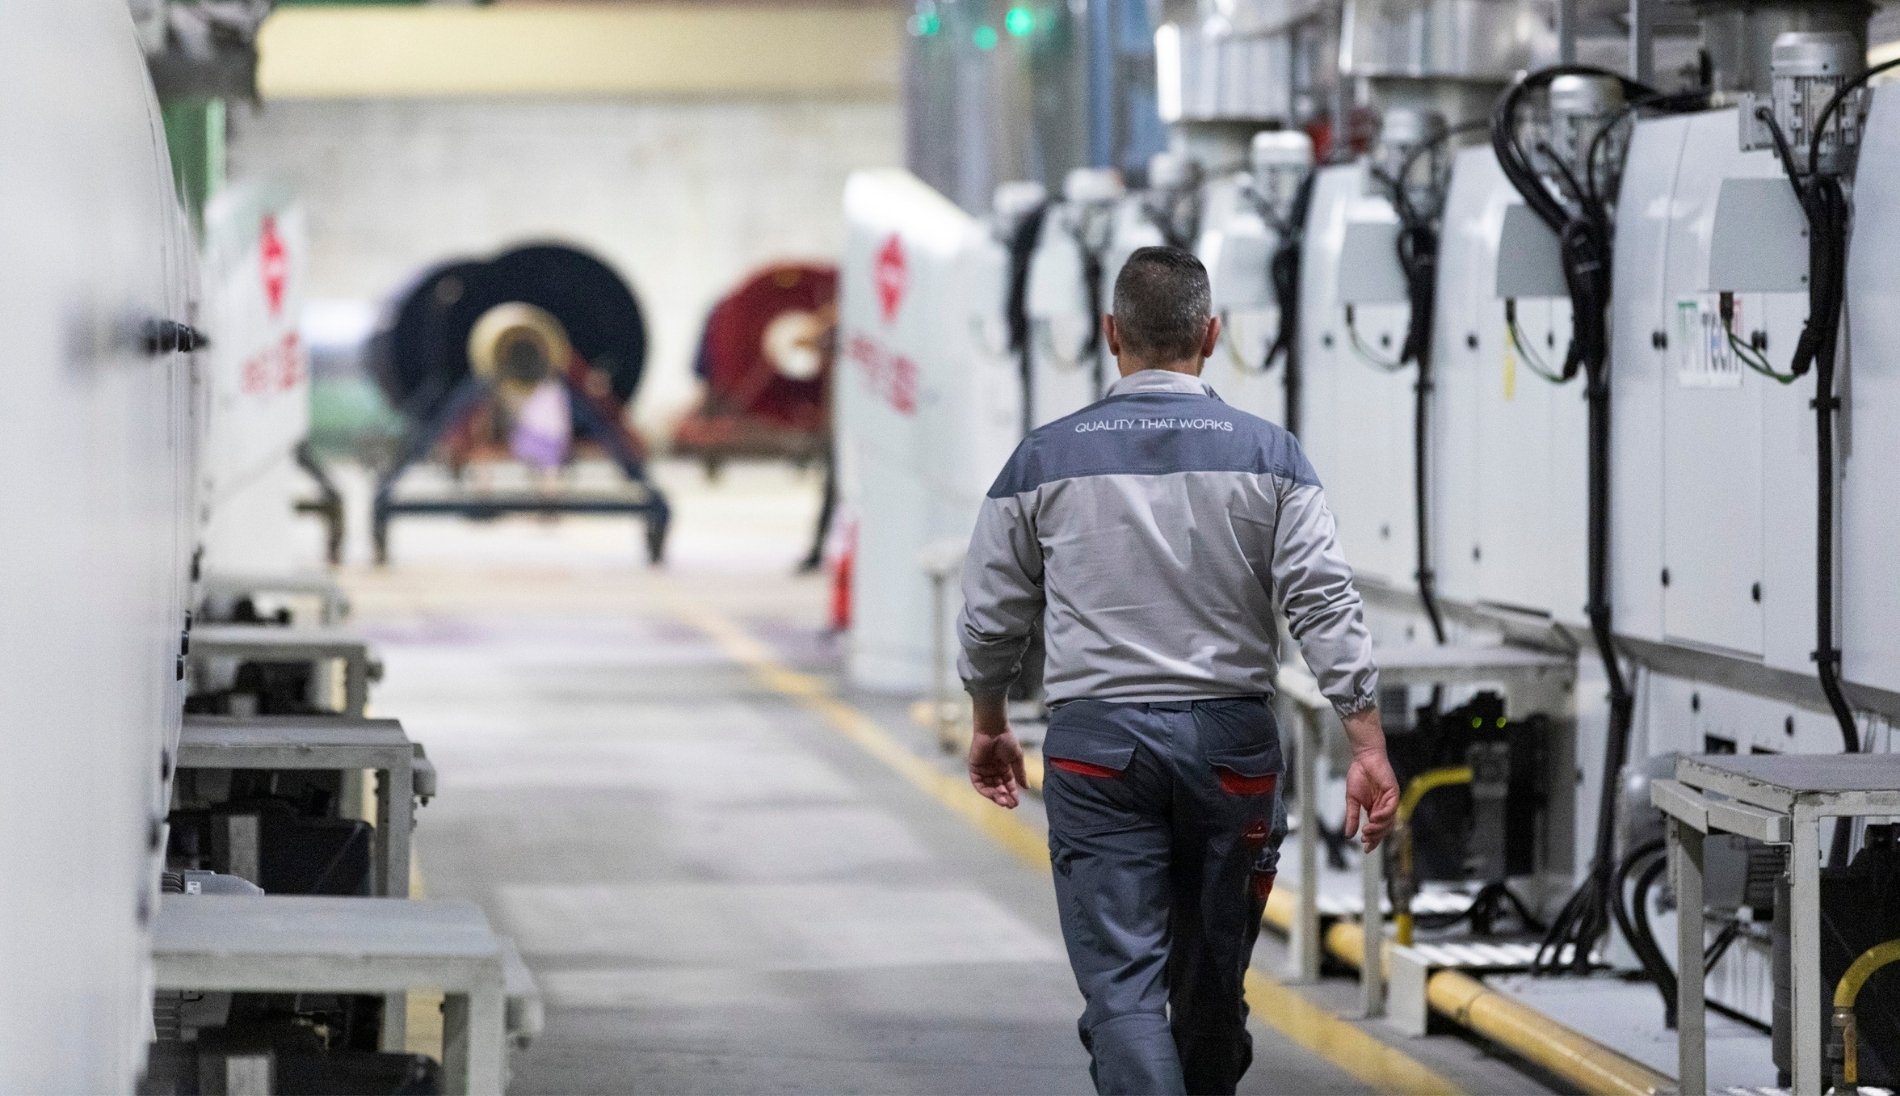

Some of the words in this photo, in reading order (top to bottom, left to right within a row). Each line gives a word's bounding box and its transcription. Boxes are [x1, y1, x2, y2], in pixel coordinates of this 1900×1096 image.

[1075, 419, 1134, 432] QUALITY
[1139, 418, 1176, 429] THAT
[1179, 418, 1233, 431] WORKS
